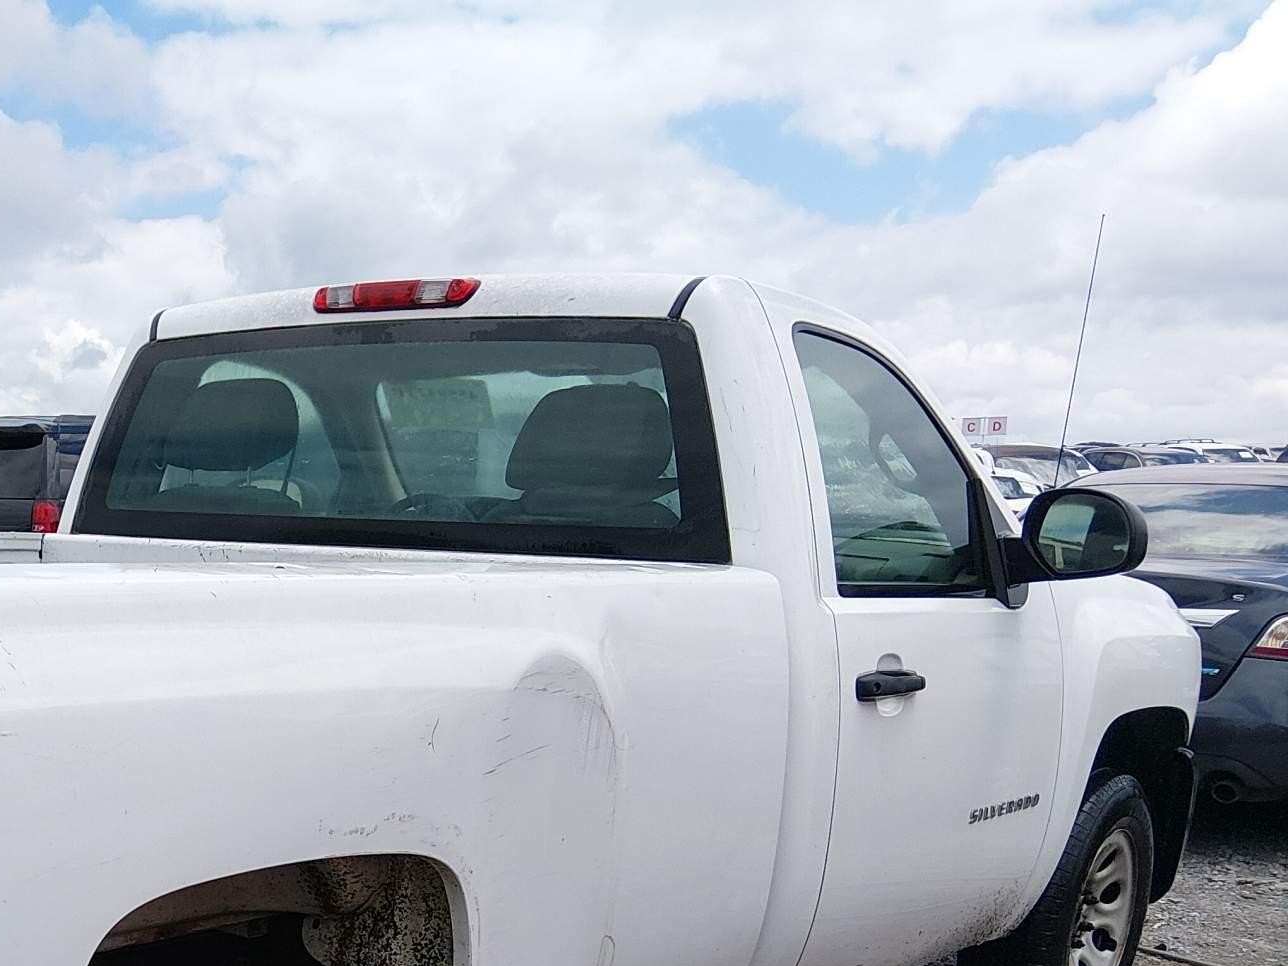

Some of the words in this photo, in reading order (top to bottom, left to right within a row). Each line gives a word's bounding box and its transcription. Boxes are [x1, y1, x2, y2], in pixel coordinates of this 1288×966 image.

[967, 422, 976, 433] C
[992, 421, 1002, 432] D
[968, 793, 1041, 825] SILVERADO
